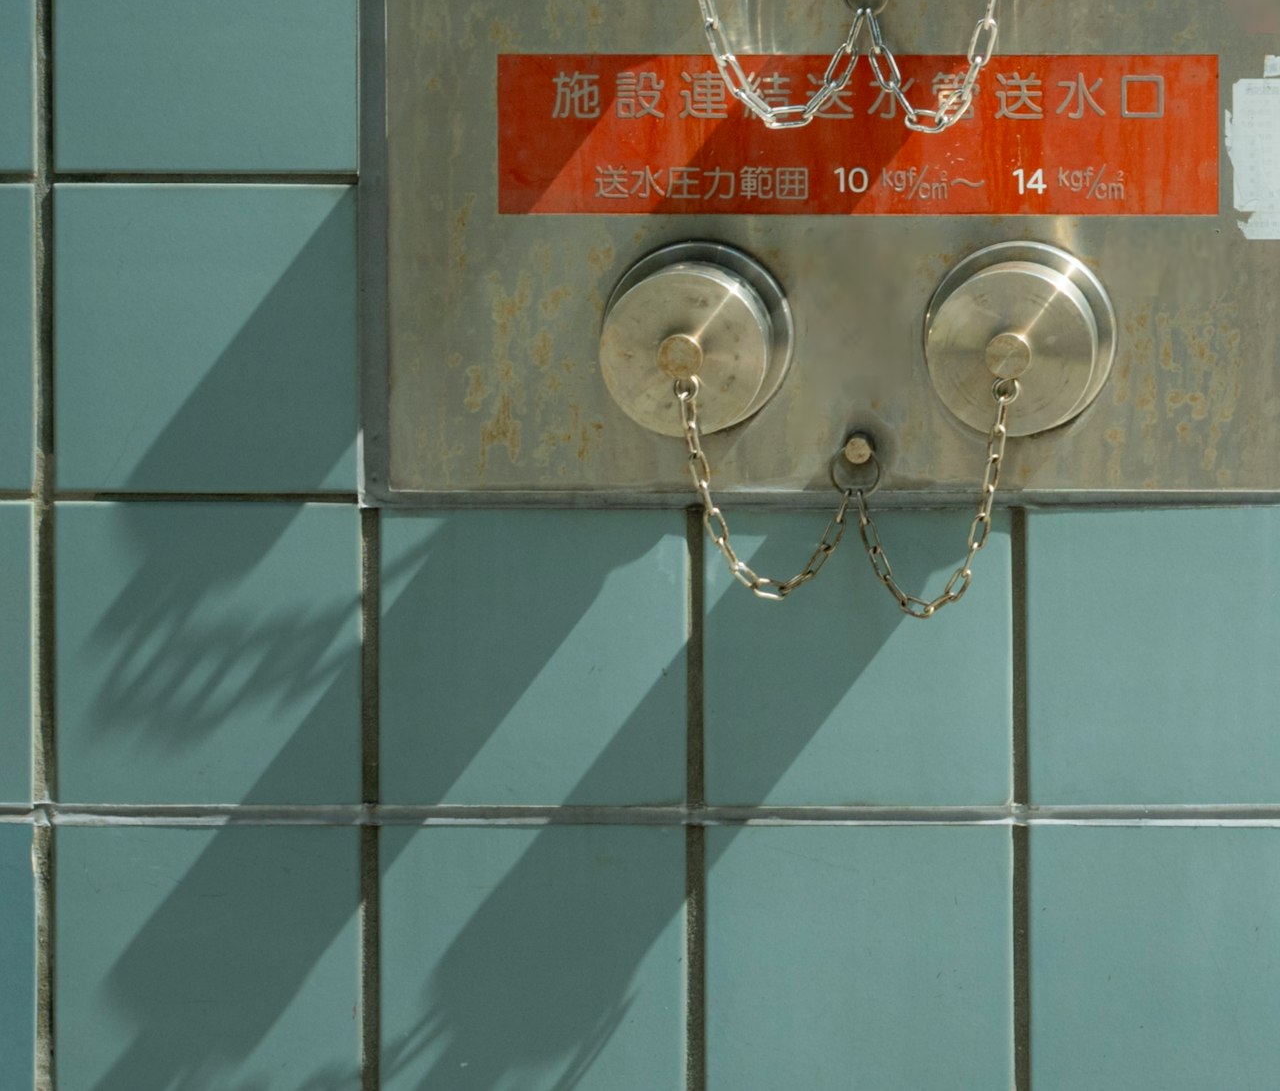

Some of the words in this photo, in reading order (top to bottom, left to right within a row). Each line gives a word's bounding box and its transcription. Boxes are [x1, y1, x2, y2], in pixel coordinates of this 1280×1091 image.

[552, 71, 1165, 120] 施設連結送水管送水口
[593, 165, 808, 200] 送水圧力範囲
[833, 167, 868, 194] 10
[1012, 168, 1047, 195] 14
